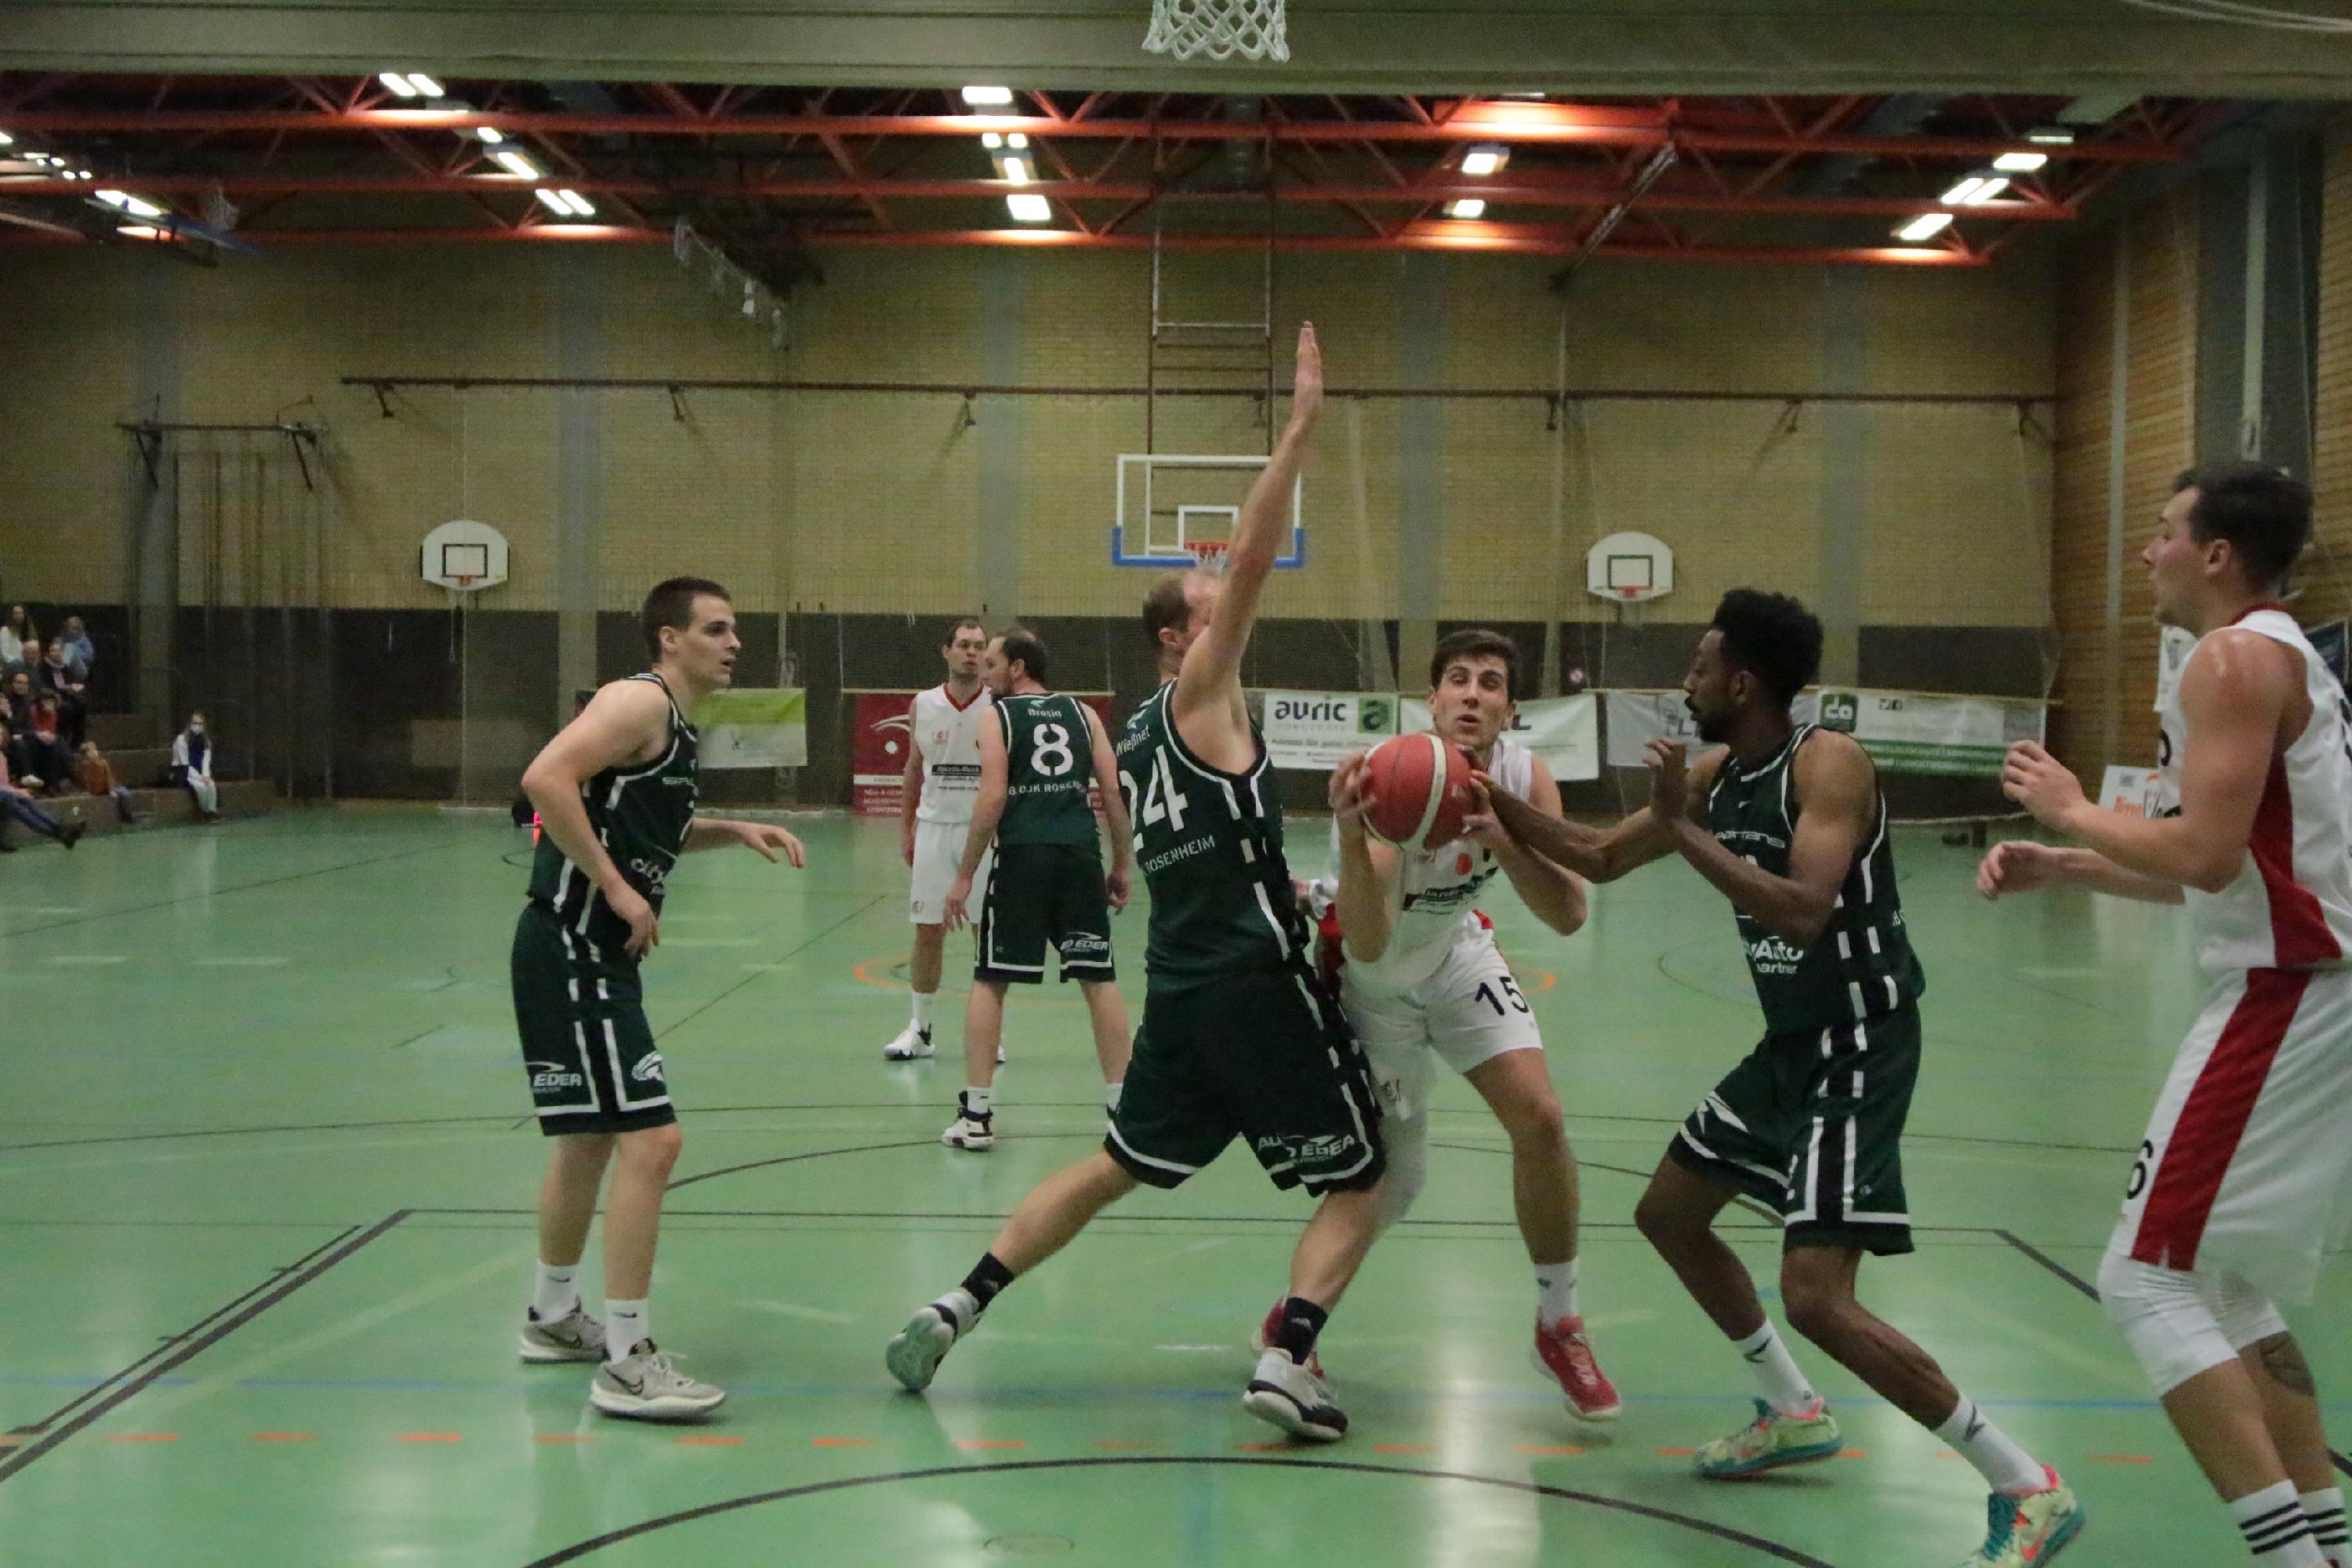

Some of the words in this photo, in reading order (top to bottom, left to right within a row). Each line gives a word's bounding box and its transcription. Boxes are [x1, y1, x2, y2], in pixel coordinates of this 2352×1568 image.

[1028, 708, 1062, 718] Brosig
[1275, 693, 1347, 721] auric
[1031, 723, 1073, 776] 8
[1019, 784, 1040, 793] DJK
[1119, 745, 1189, 853] 24
[1076, 940, 1109, 950] EDER
[1475, 977, 1529, 1016] 15
[533, 1073, 582, 1087] EDER
[1301, 1134, 1355, 1156] EDER
